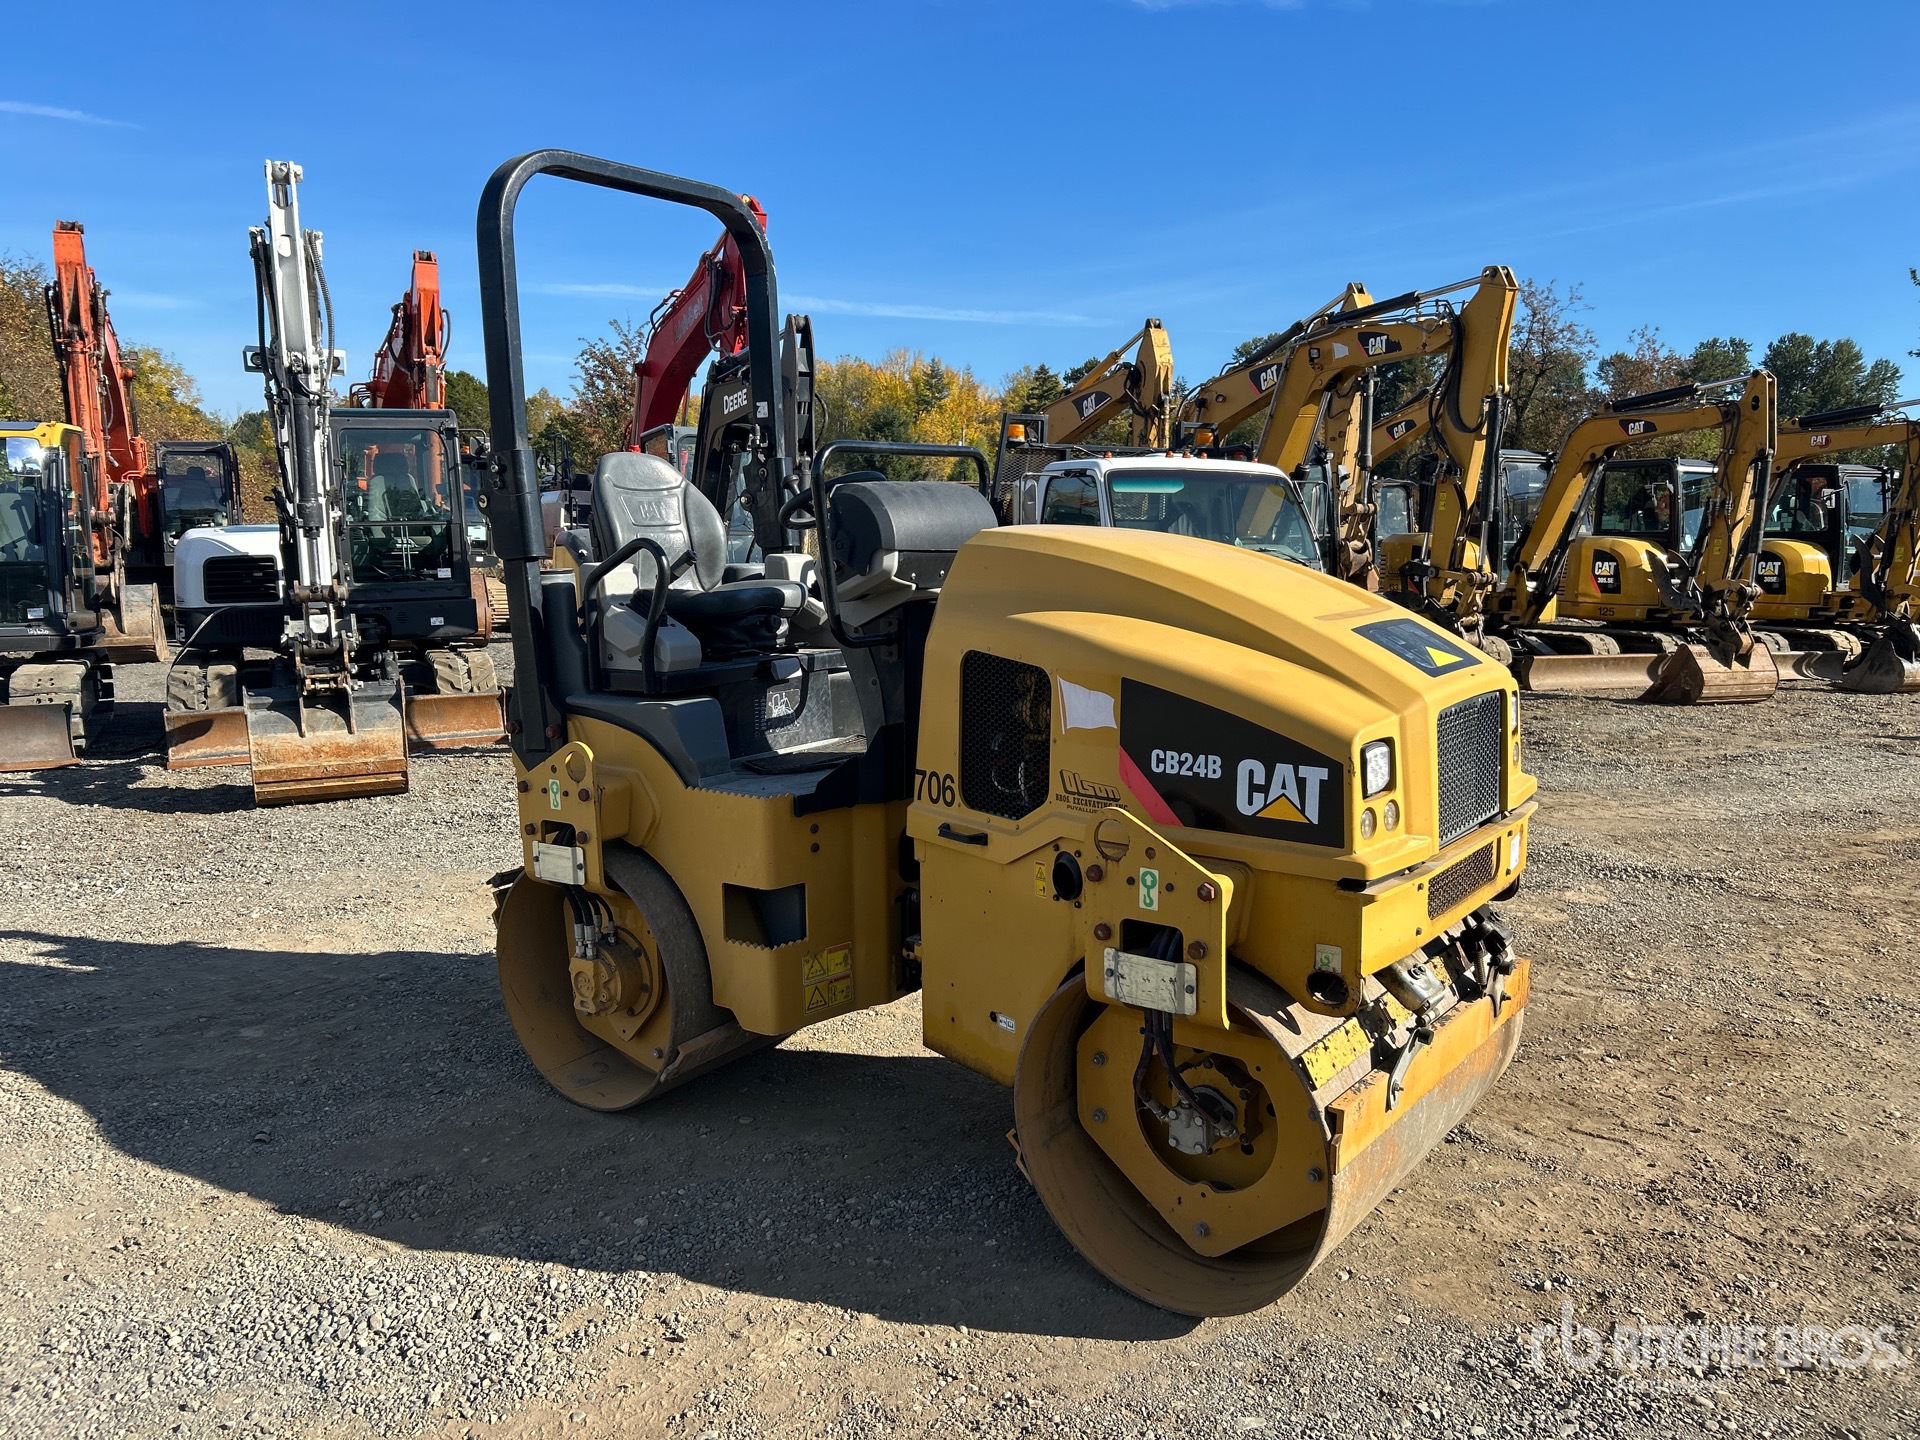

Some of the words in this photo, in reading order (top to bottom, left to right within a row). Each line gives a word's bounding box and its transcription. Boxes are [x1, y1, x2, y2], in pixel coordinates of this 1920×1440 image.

[1368, 335, 1387, 356] CAT
[1260, 364, 1278, 390] CAT
[723, 388, 748, 415] DEERE
[1082, 393, 1096, 417] CAT
[1393, 421, 1406, 439] CAT
[1628, 420, 1645, 436] CAT
[1810, 435, 1827, 447] CAT
[1594, 561, 1617, 576] CAT
[1757, 561, 1782, 576] CAT
[1598, 607, 1615, 617] 125
[1151, 749, 1222, 780] CB24B
[914, 768, 956, 808] 706
[1060, 769, 1121, 802] Olson
[1236, 759, 1329, 825] CAT
